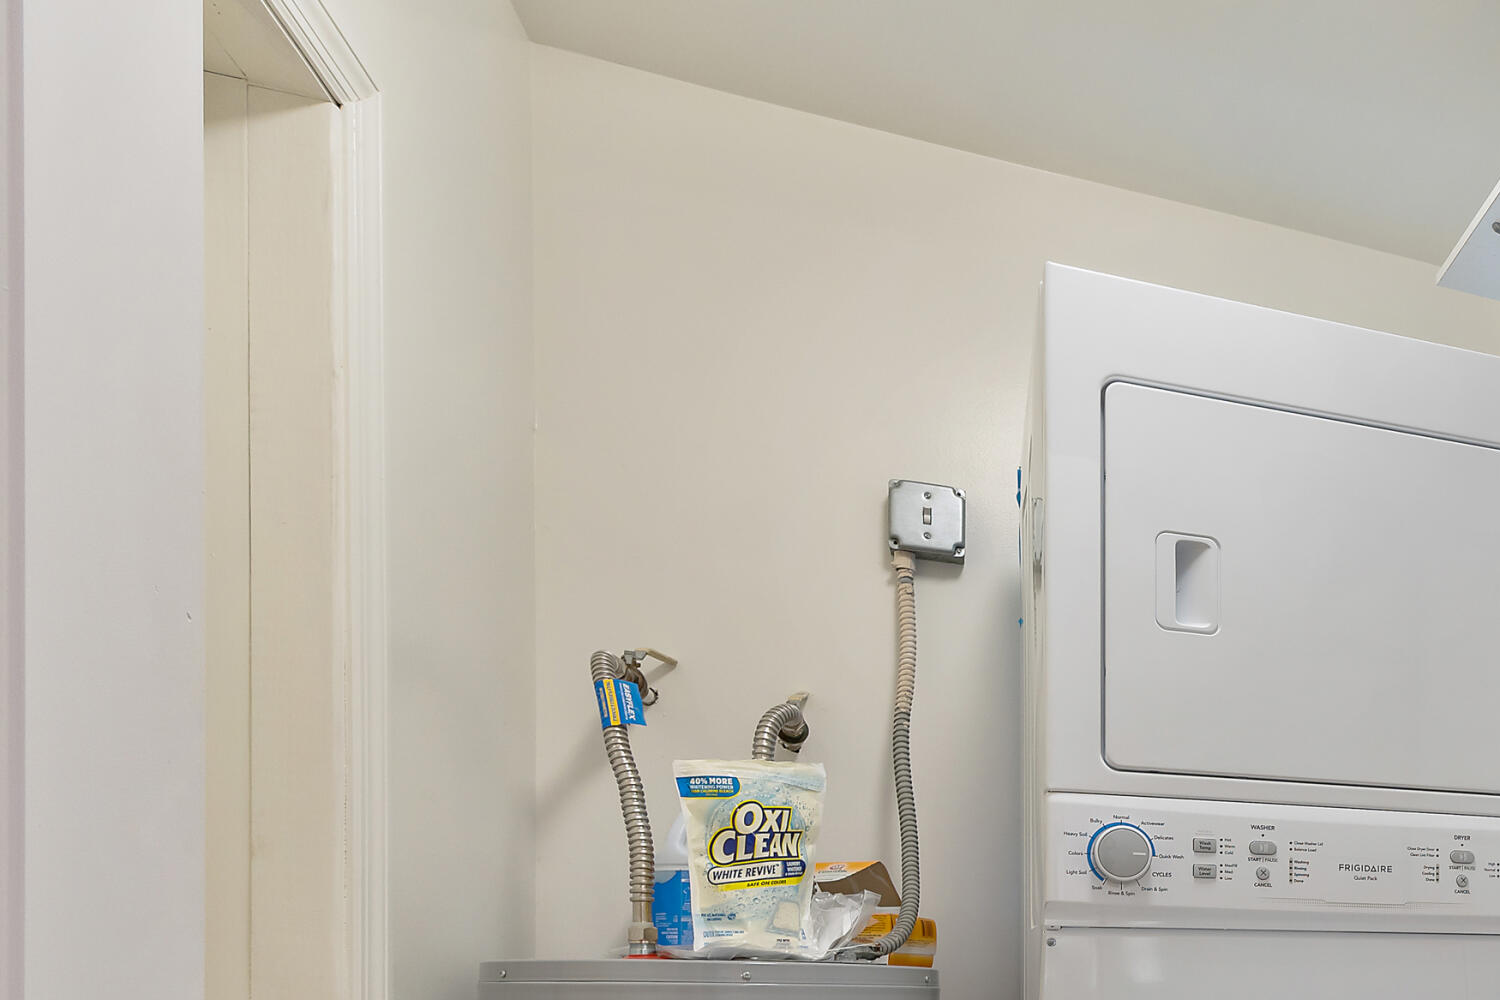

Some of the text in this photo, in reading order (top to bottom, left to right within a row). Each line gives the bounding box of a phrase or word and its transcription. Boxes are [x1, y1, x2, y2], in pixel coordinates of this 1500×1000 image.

[622, 683, 636, 721] EASYFLEX
[690, 777, 733, 785] 40% MORE
[734, 802, 790, 835] OXI
[711, 830, 800, 865] CLEAN
[713, 868, 743, 881] WHITE
[1338, 863, 1393, 873] FRIGIDAIRE
